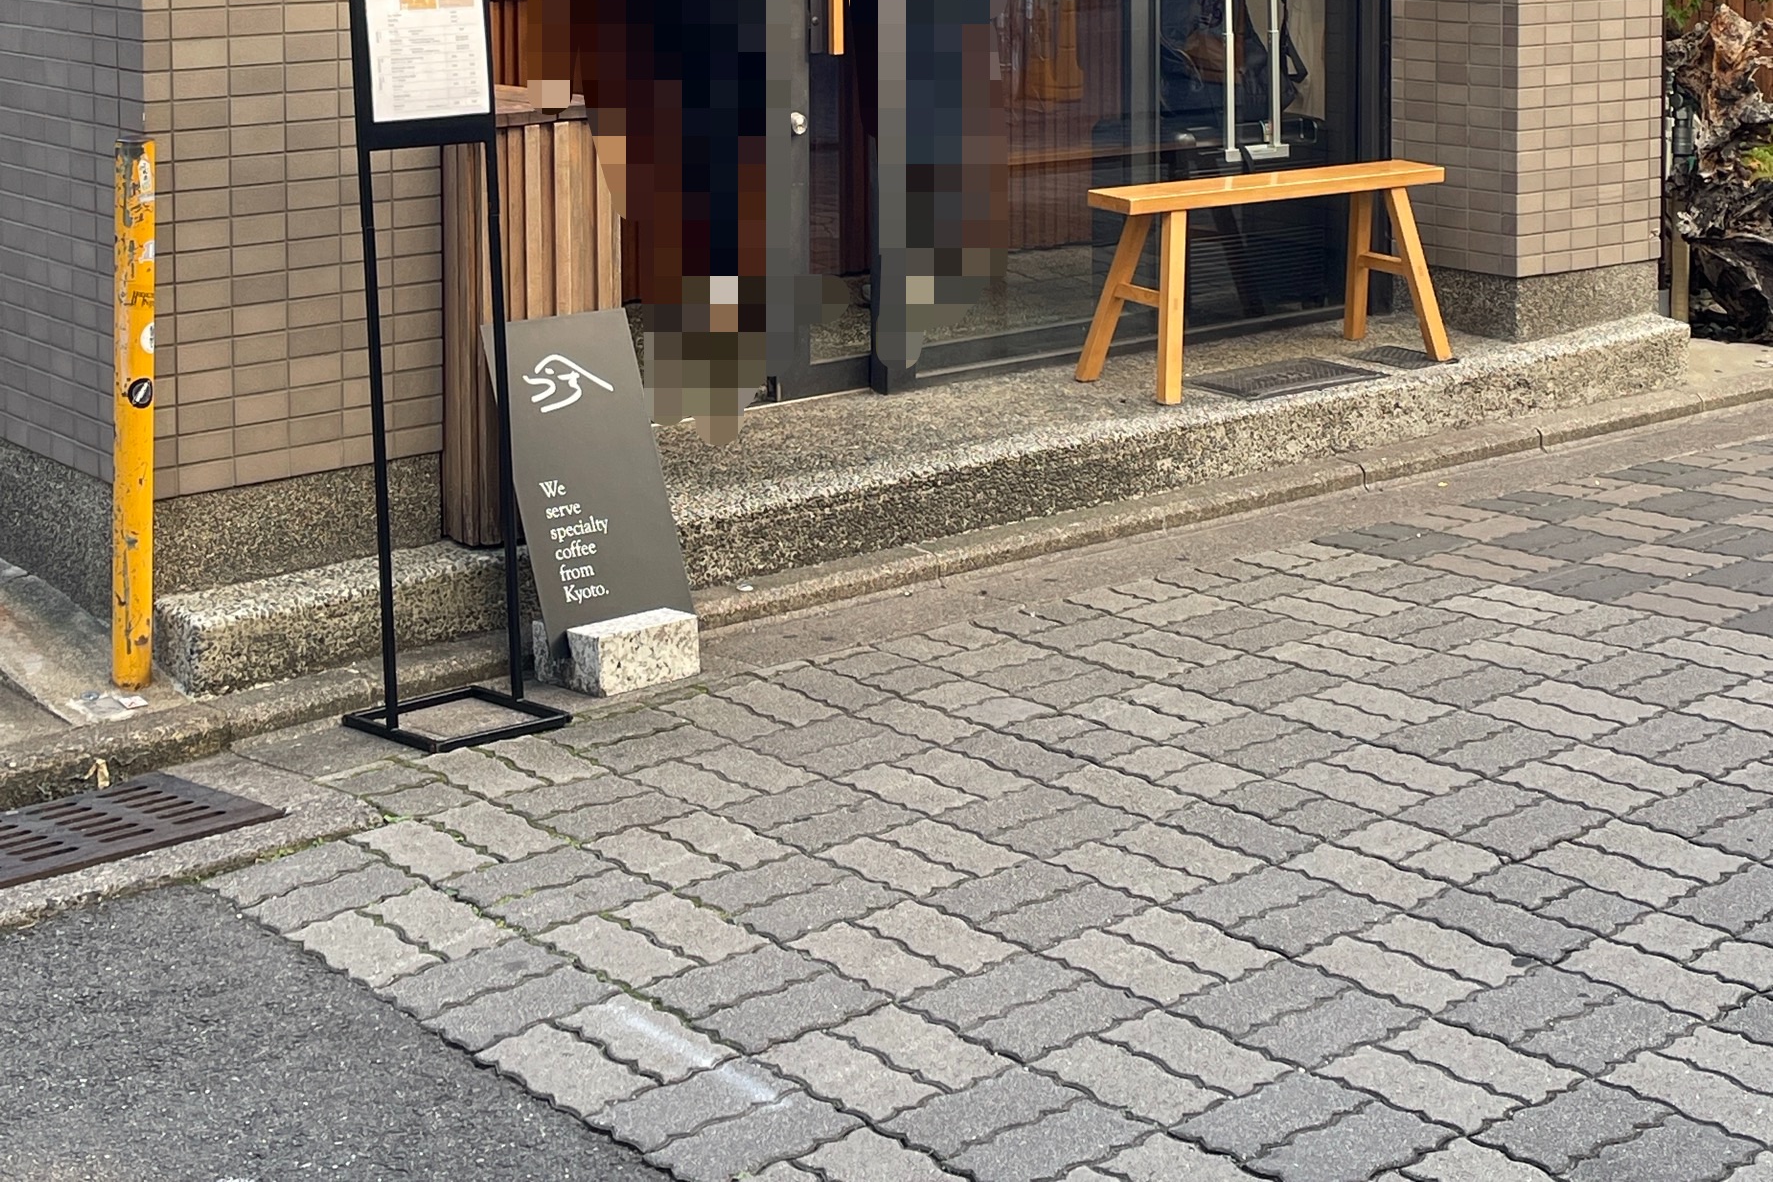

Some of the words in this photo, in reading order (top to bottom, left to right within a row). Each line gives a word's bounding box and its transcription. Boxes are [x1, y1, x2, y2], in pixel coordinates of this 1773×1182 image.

[538, 480, 567, 498] We
[545, 503, 582, 520] serve
[550, 515, 609, 542] specialty
[555, 539, 598, 561] coffee
[559, 564, 595, 582] from
[563, 584, 610, 604] Kyoto.
